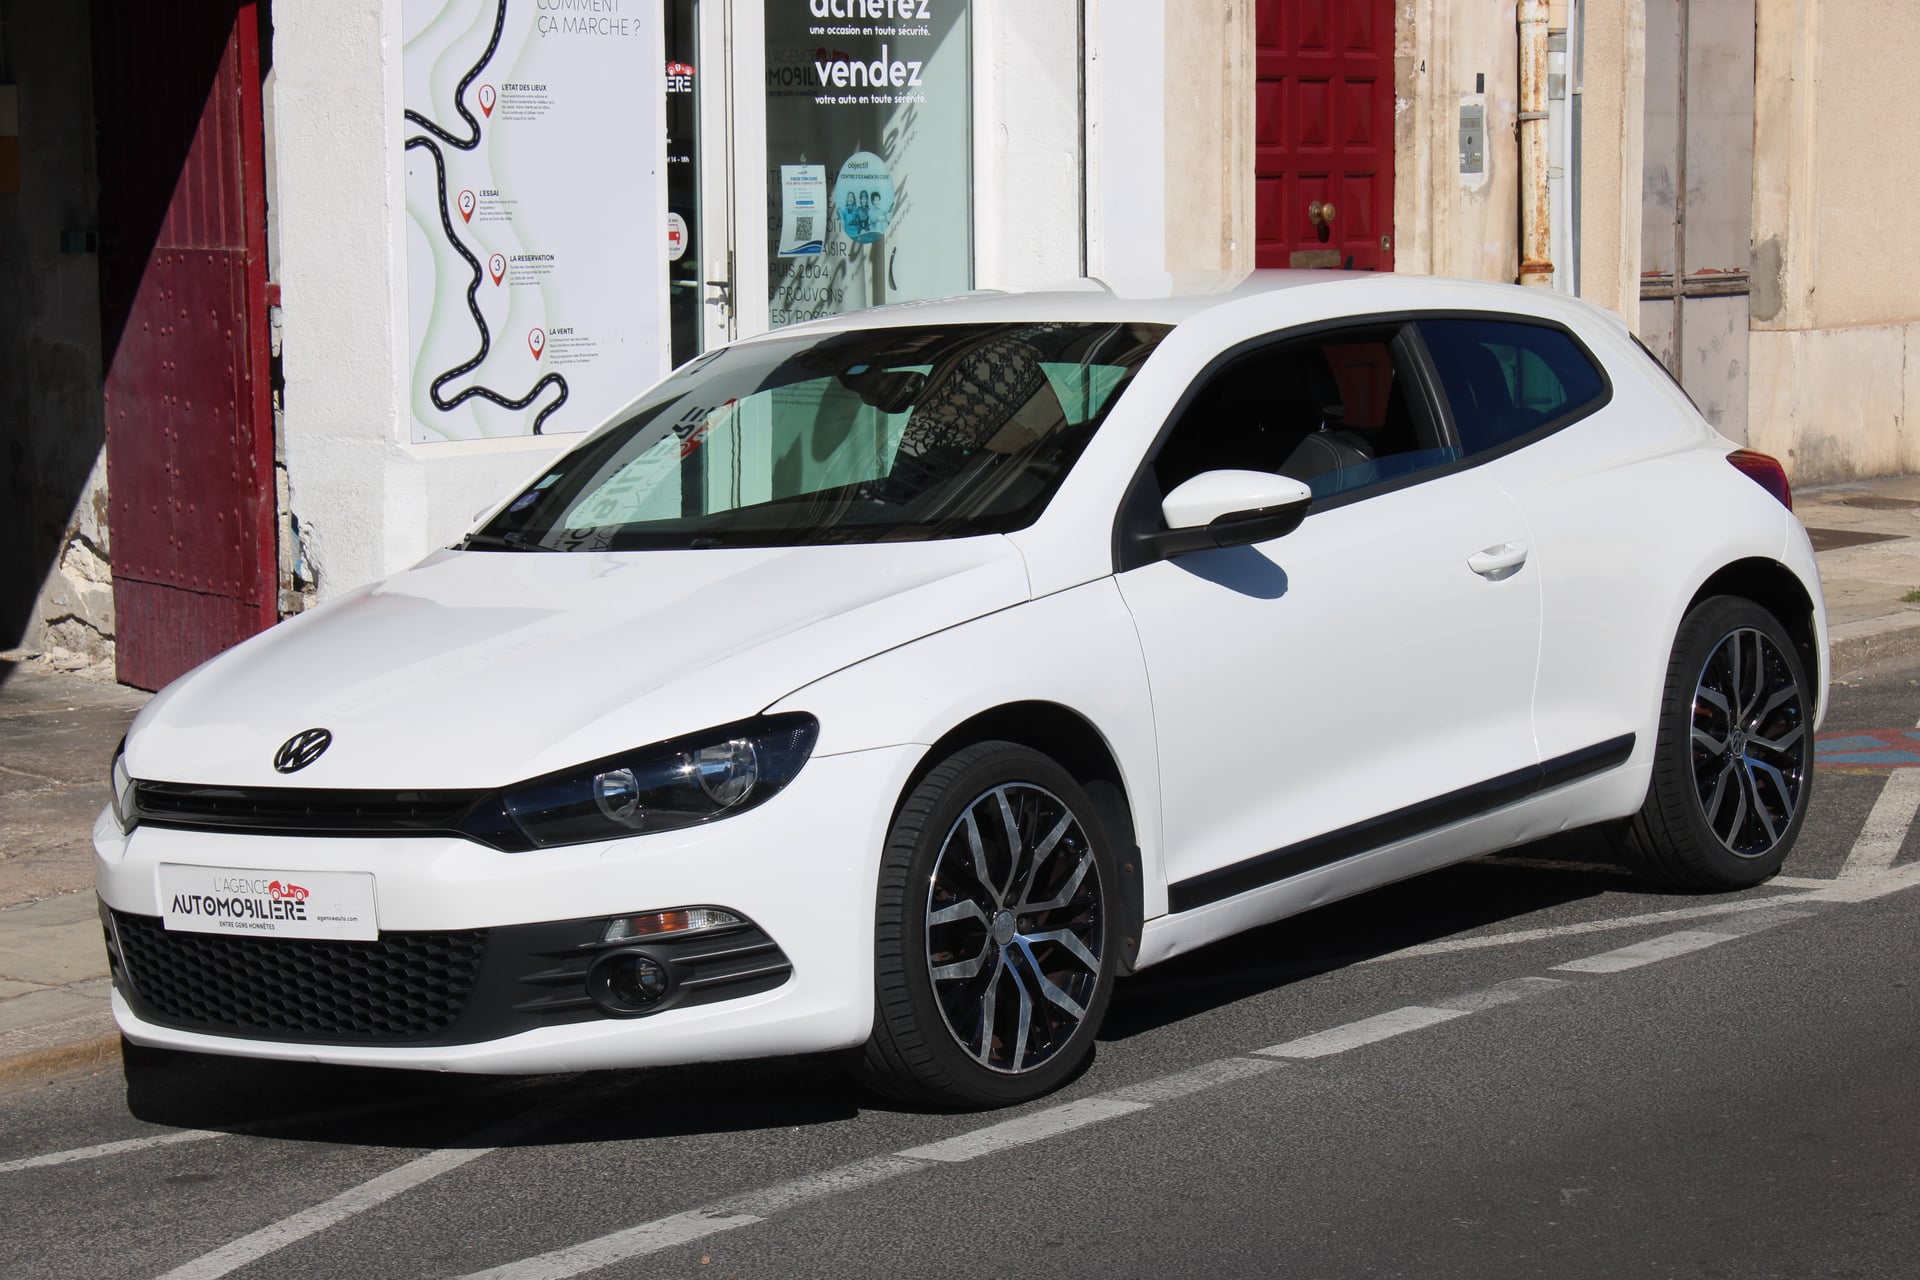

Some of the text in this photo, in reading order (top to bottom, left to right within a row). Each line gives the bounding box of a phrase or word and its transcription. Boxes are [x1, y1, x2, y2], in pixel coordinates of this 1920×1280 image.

[537, 15, 641, 38] ÇA MARCHE ?
[809, 24, 931, 36] une occasion en toute sécurité.
[814, 43, 923, 87] vendez
[1420, 60, 1426, 74] 4
[531, 84, 548, 92] LIEUX
[485, 90, 490, 102] 1
[815, 92, 928, 105] votre auto en toute sérénité.
[464, 196, 471, 208] 2
[517, 254, 555, 262] RESERVATION
[494, 259, 501, 272] 3
[779, 287, 843, 303] PROUVONS
[557, 327, 574, 335] VENTE
[533, 334, 540, 345] 4
[213, 876, 270, 895] L'AGENCE
[235, 922, 248, 930] GENS
